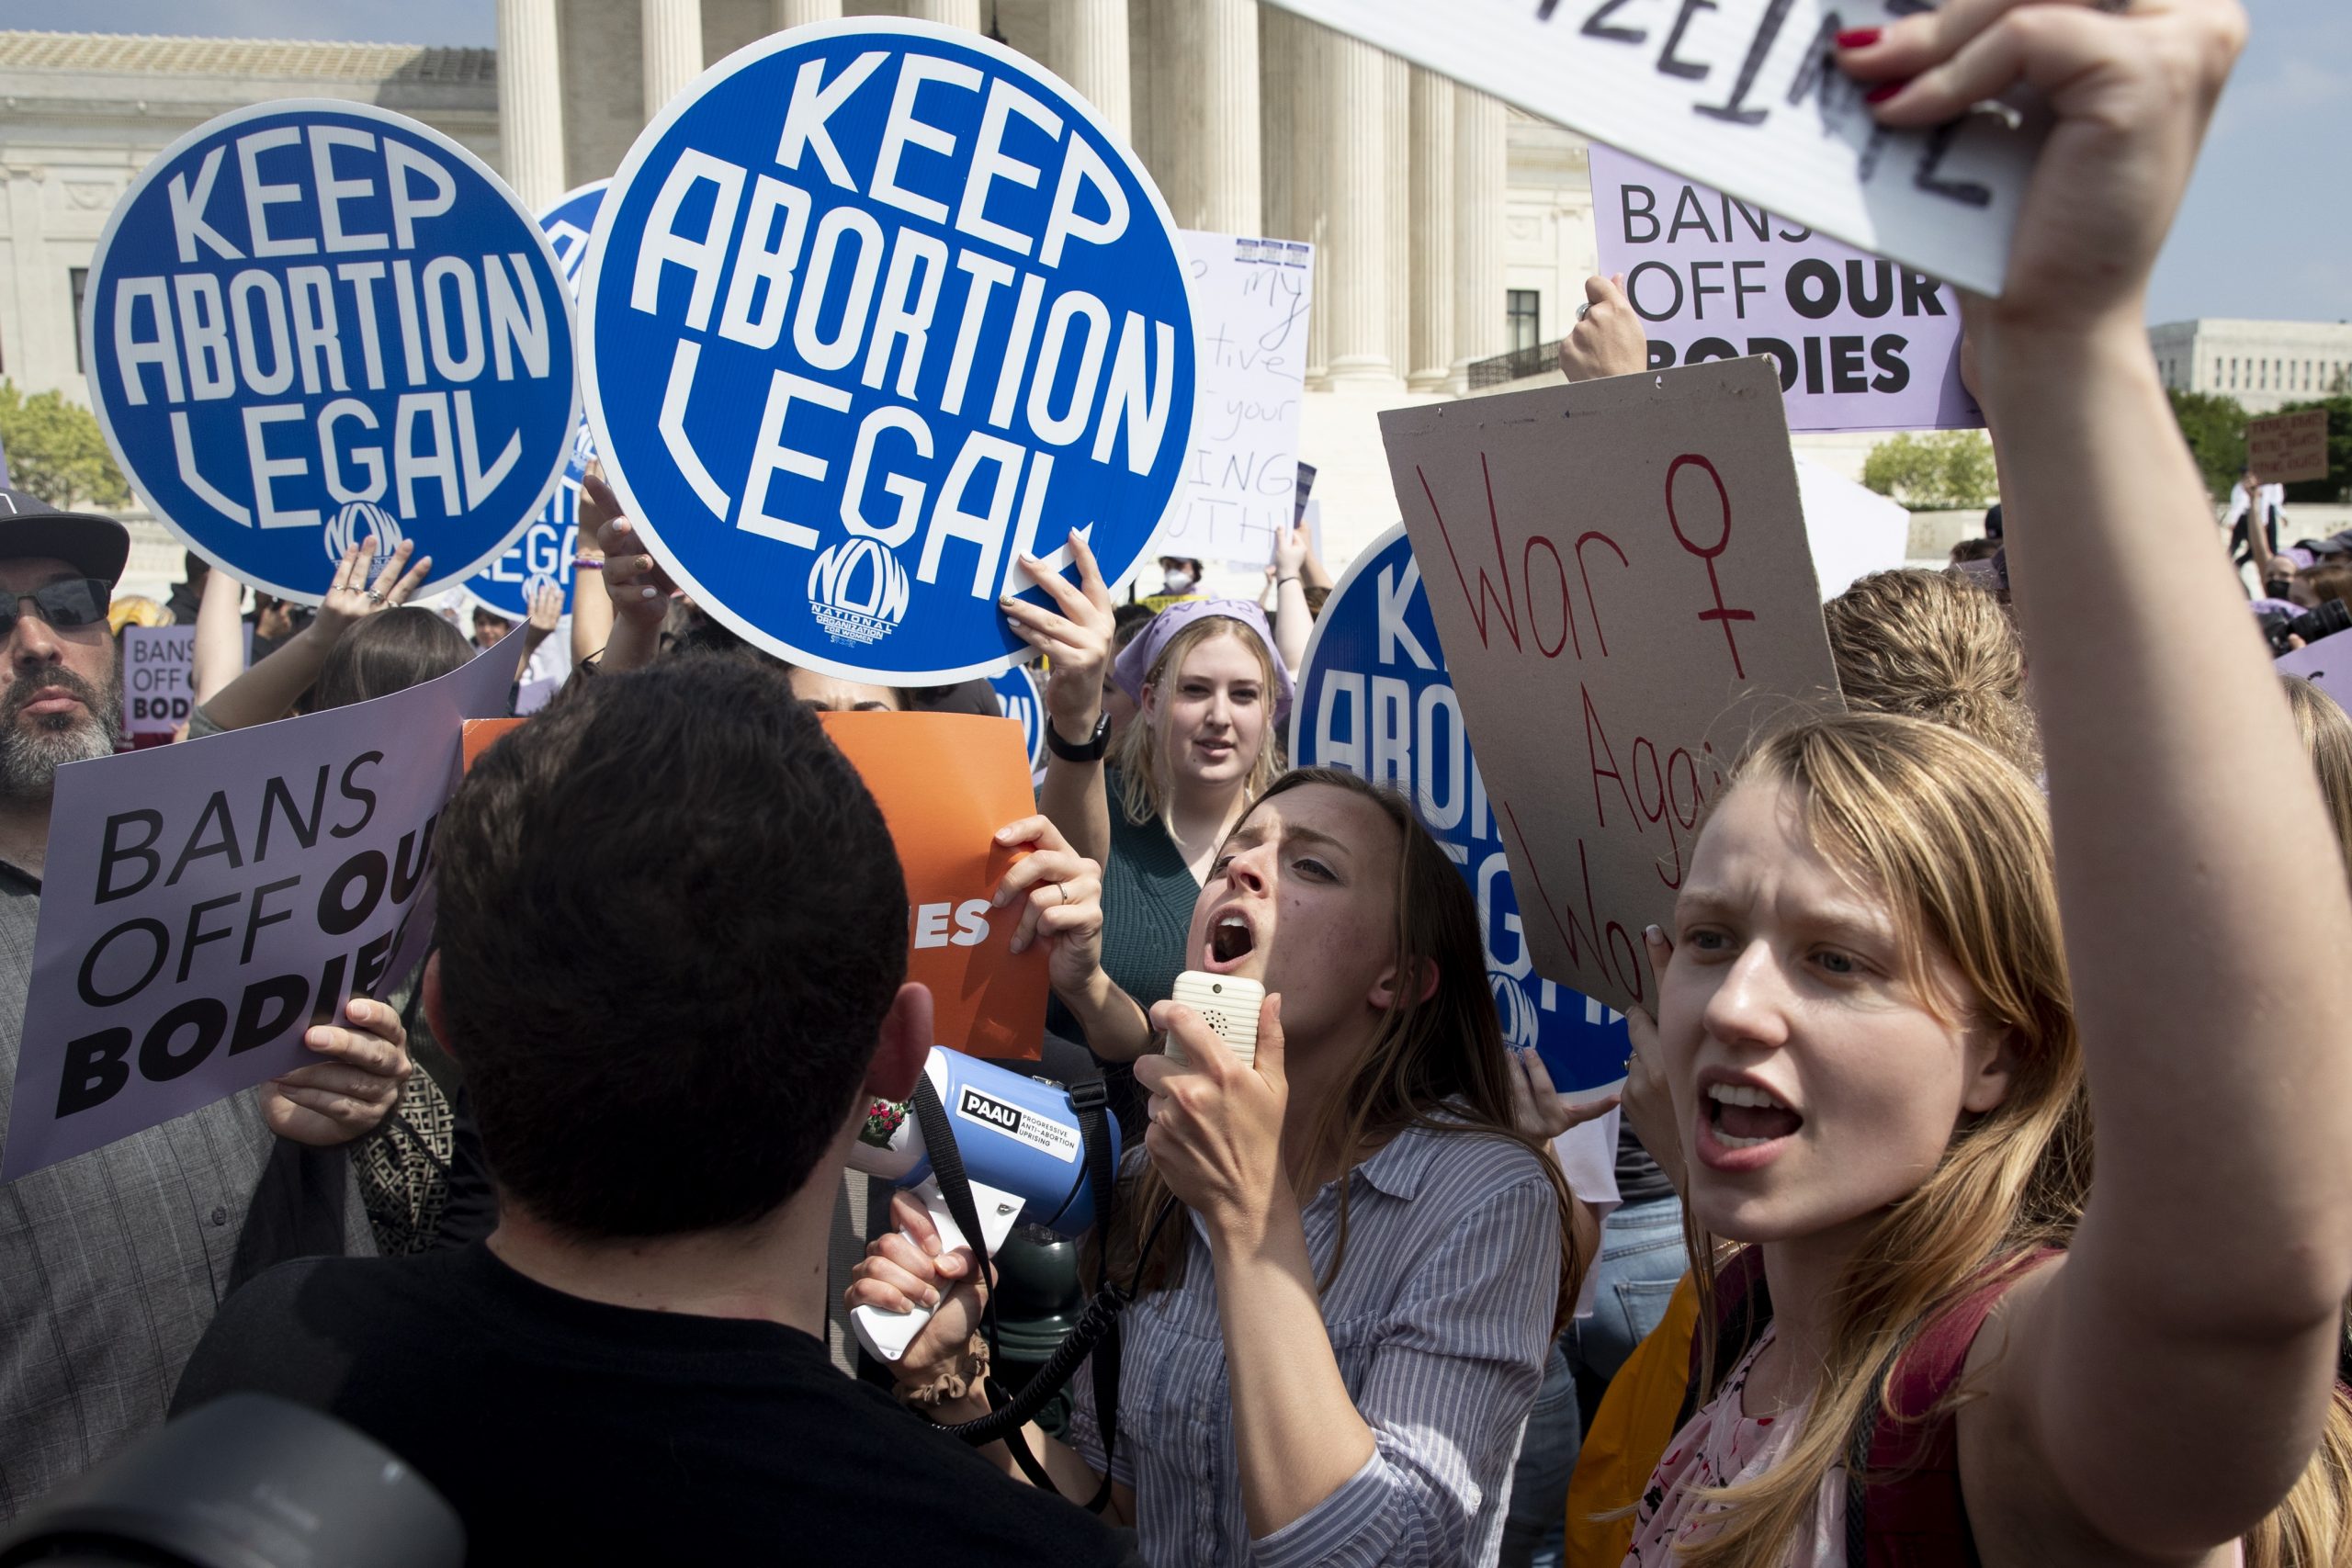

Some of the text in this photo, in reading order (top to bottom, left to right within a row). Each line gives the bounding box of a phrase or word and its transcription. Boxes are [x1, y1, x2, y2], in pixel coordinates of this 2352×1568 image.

[168, 125, 457, 263] KEEP
[775, 51, 1130, 268] KEEP
[630, 147, 1174, 476] ABORTION
[1243, 268, 1311, 351] my
[1627, 258, 1947, 321] OFF OUR
[114, 253, 549, 405] ABORTION
[1205, 322, 1302, 383] tive
[1210, 400, 1296, 441] your
[170, 390, 522, 529] LEGAL
[659, 338, 1093, 601] LEGAL
[1189, 449, 1293, 495] ING
[808, 538, 910, 623] NOW
[1416, 452, 1628, 661] War
[811, 604, 893, 632] NATIONAL
[816, 615, 883, 638] ORGANIZATION
[825, 626, 840, 634] FOR
[842, 629, 874, 642] WOMEN
[133, 669, 181, 691] OFF
[134, 697, 191, 720] BOD
[1580, 681, 1721, 889] Agai
[95, 750, 384, 906] BANS
[77, 808, 442, 1009] OFF OU
[55, 919, 404, 1120] BODIE
[1487, 972, 1539, 1049] OW
[967, 1095, 1016, 1126] PAAU
[1019, 1129, 1051, 1146] UPRISING
[1021, 1122, 1075, 1148] ANTI-ABORTION
[1022, 1114, 1068, 1137] PROGRESSIVE
